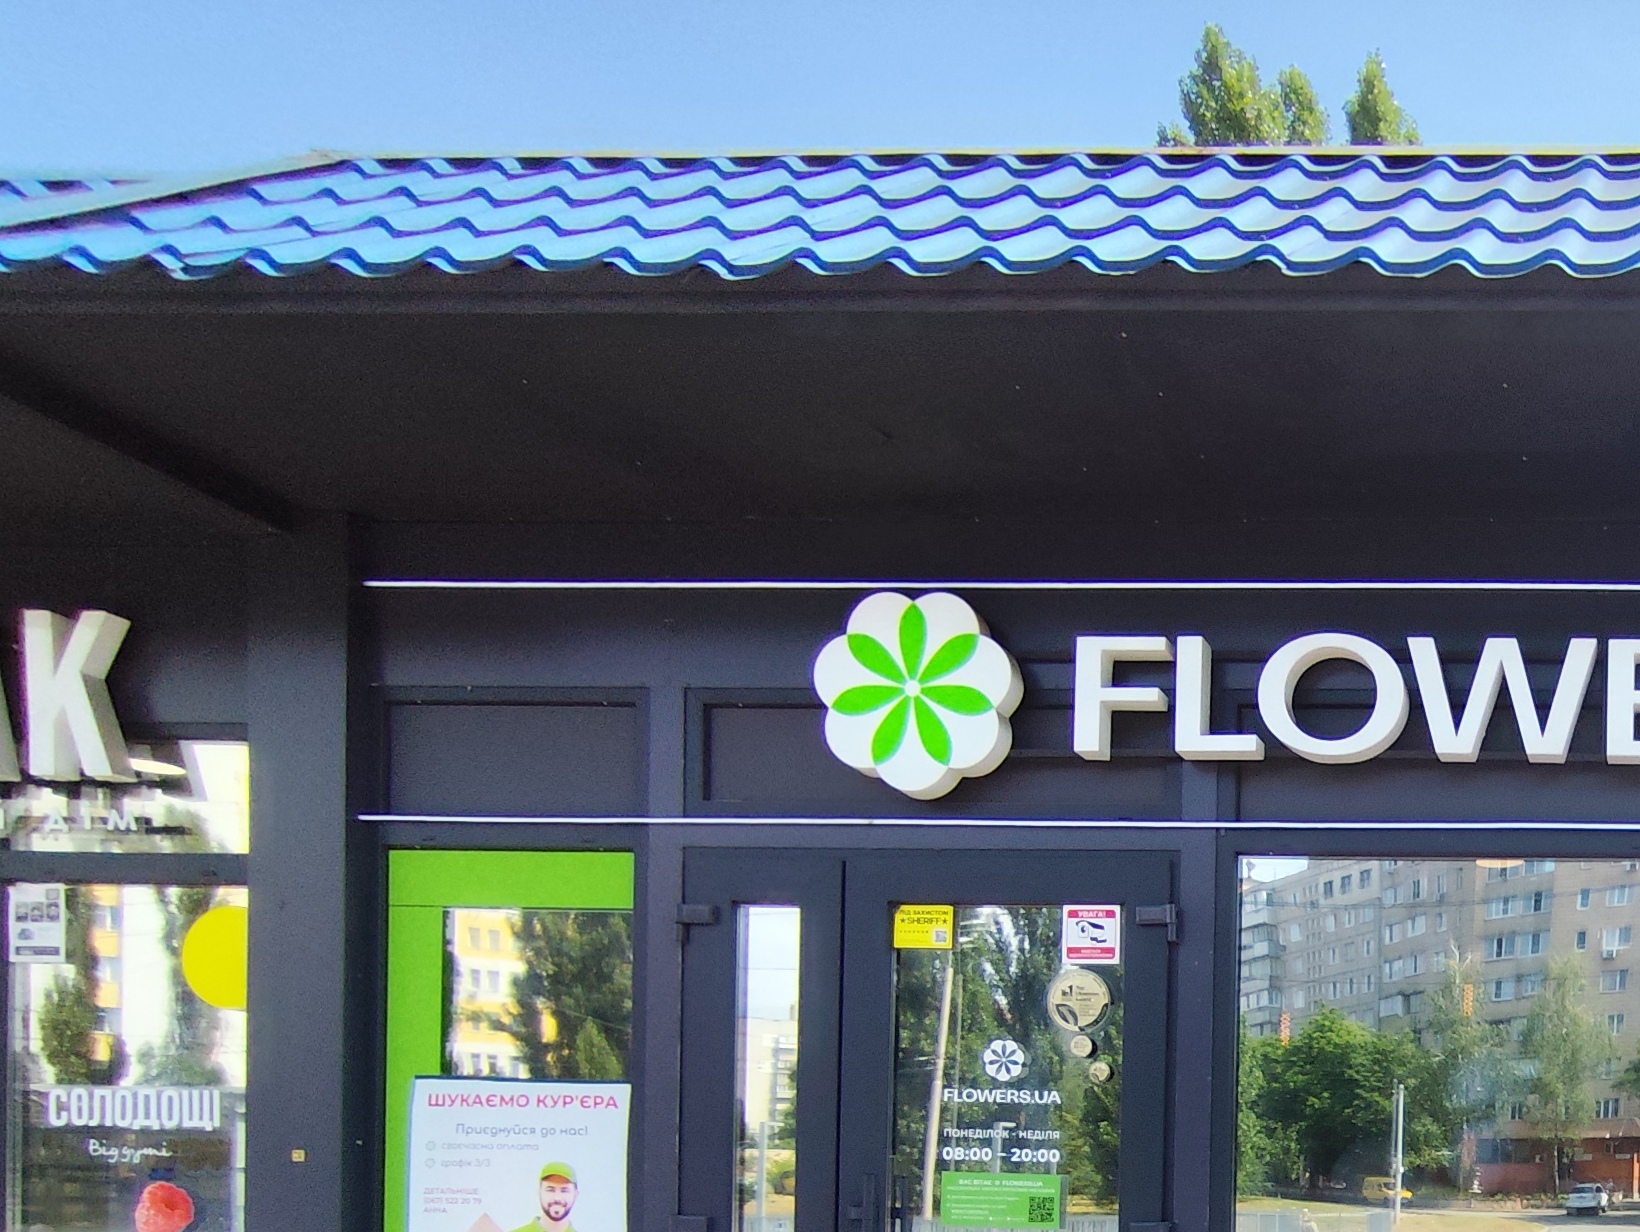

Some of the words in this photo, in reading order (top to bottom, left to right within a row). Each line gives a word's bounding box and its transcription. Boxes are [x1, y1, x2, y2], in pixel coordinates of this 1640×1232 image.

[0, 608, 138, 783] К
[45, 800, 138, 833] ДІМ
[907, 917, 942, 925] SHERIFF
[427, 1093, 530, 1108] ШУКАЄМО
[536, 1094, 619, 1109] КУР'ЄРА
[943, 1088, 1062, 1105] FLOWERS.UA
[48, 1087, 221, 1131] СОЛОДОЩІ
[455, 1123, 536, 1138] Приєднуйся
[540, 1126, 556, 1138] до
[560, 1126, 589, 1137] нас!
[943, 1128, 1010, 1139] ПОНЕДІЛОК
[1018, 1130, 1061, 1140] НЕДІЛЯ
[496, 1142, 540, 1151] оплата
[942, 1147, 993, 1162] 08:00
[1010, 1147, 1061, 1163] 20:00
[440, 1158, 472, 1169] графік
[474, 1158, 491, 1168] 3/3
